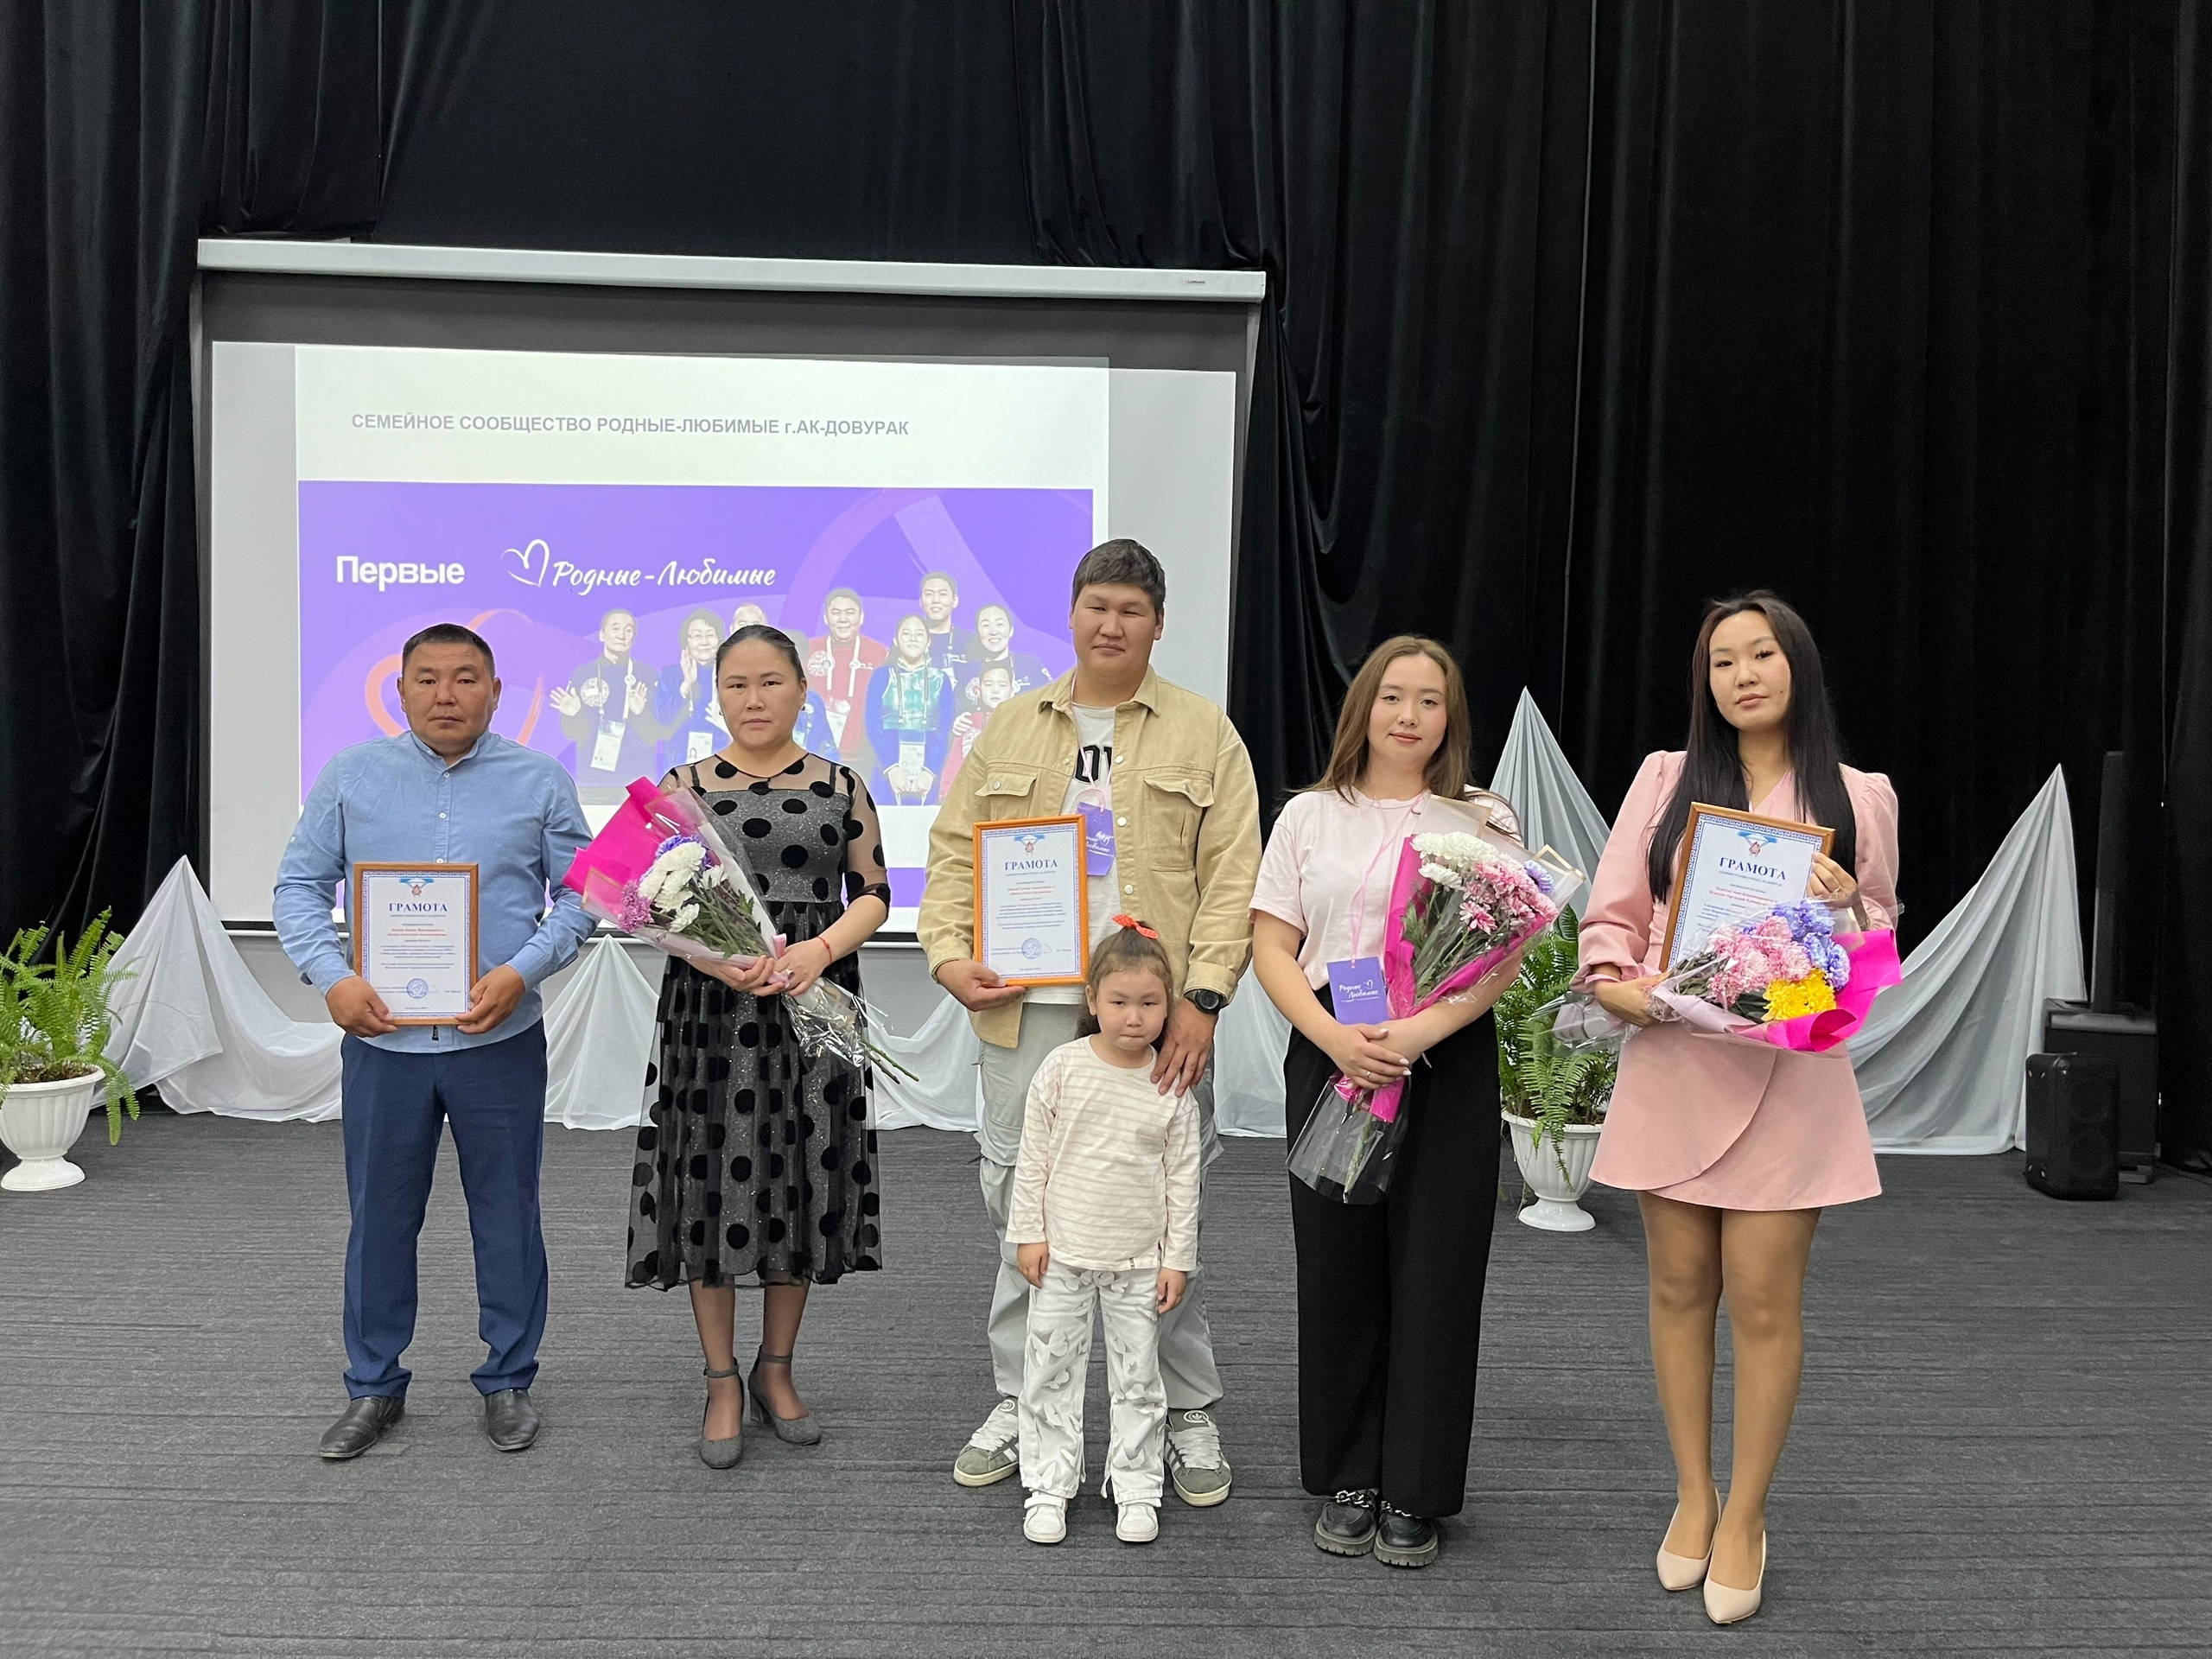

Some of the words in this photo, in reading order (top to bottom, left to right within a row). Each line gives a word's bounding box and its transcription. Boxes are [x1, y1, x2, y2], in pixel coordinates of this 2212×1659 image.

[352, 412, 454, 429] СЕМЕЙНОЕ
[460, 416, 591, 433] СООБЩЕСТВО
[597, 417, 779, 434] РОДНЫЕ-ЛЮБИМЫЕ
[785, 420, 909, 437] г.АК-ДОВУРАК
[336, 556, 465, 591] Первые
[552, 558, 776, 595] Родные-Любимые
[1005, 859, 1058, 870] ГРАМОТА
[1719, 857, 1786, 880] ГРАМОТА
[389, 903, 448, 912] ГРАМОТА
